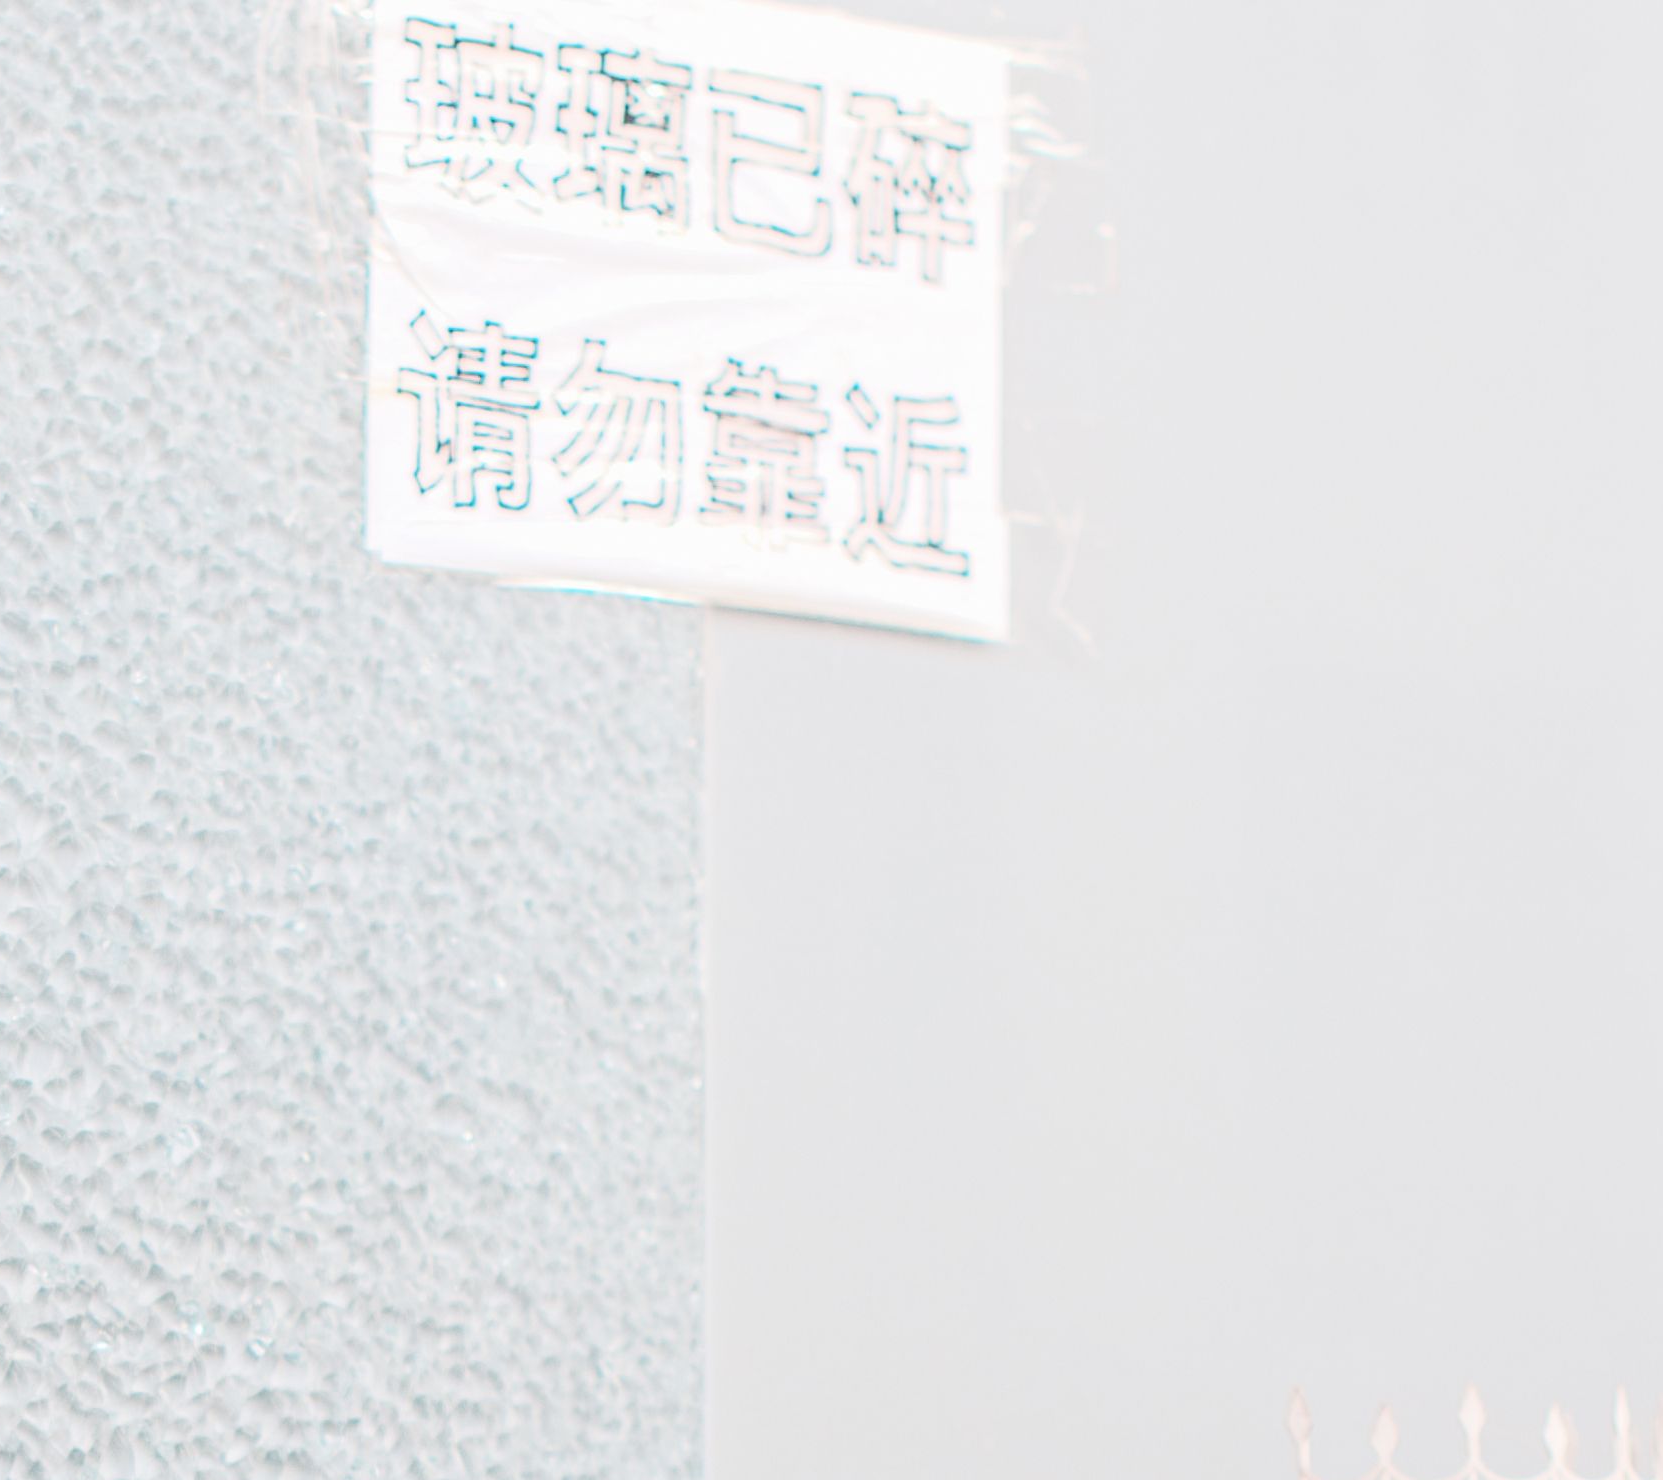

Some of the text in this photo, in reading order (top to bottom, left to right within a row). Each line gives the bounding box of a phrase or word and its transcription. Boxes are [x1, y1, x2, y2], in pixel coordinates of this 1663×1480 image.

[403, 14, 976, 286] 玻璃已碎
[396, 309, 971, 578] 请勿靠近
